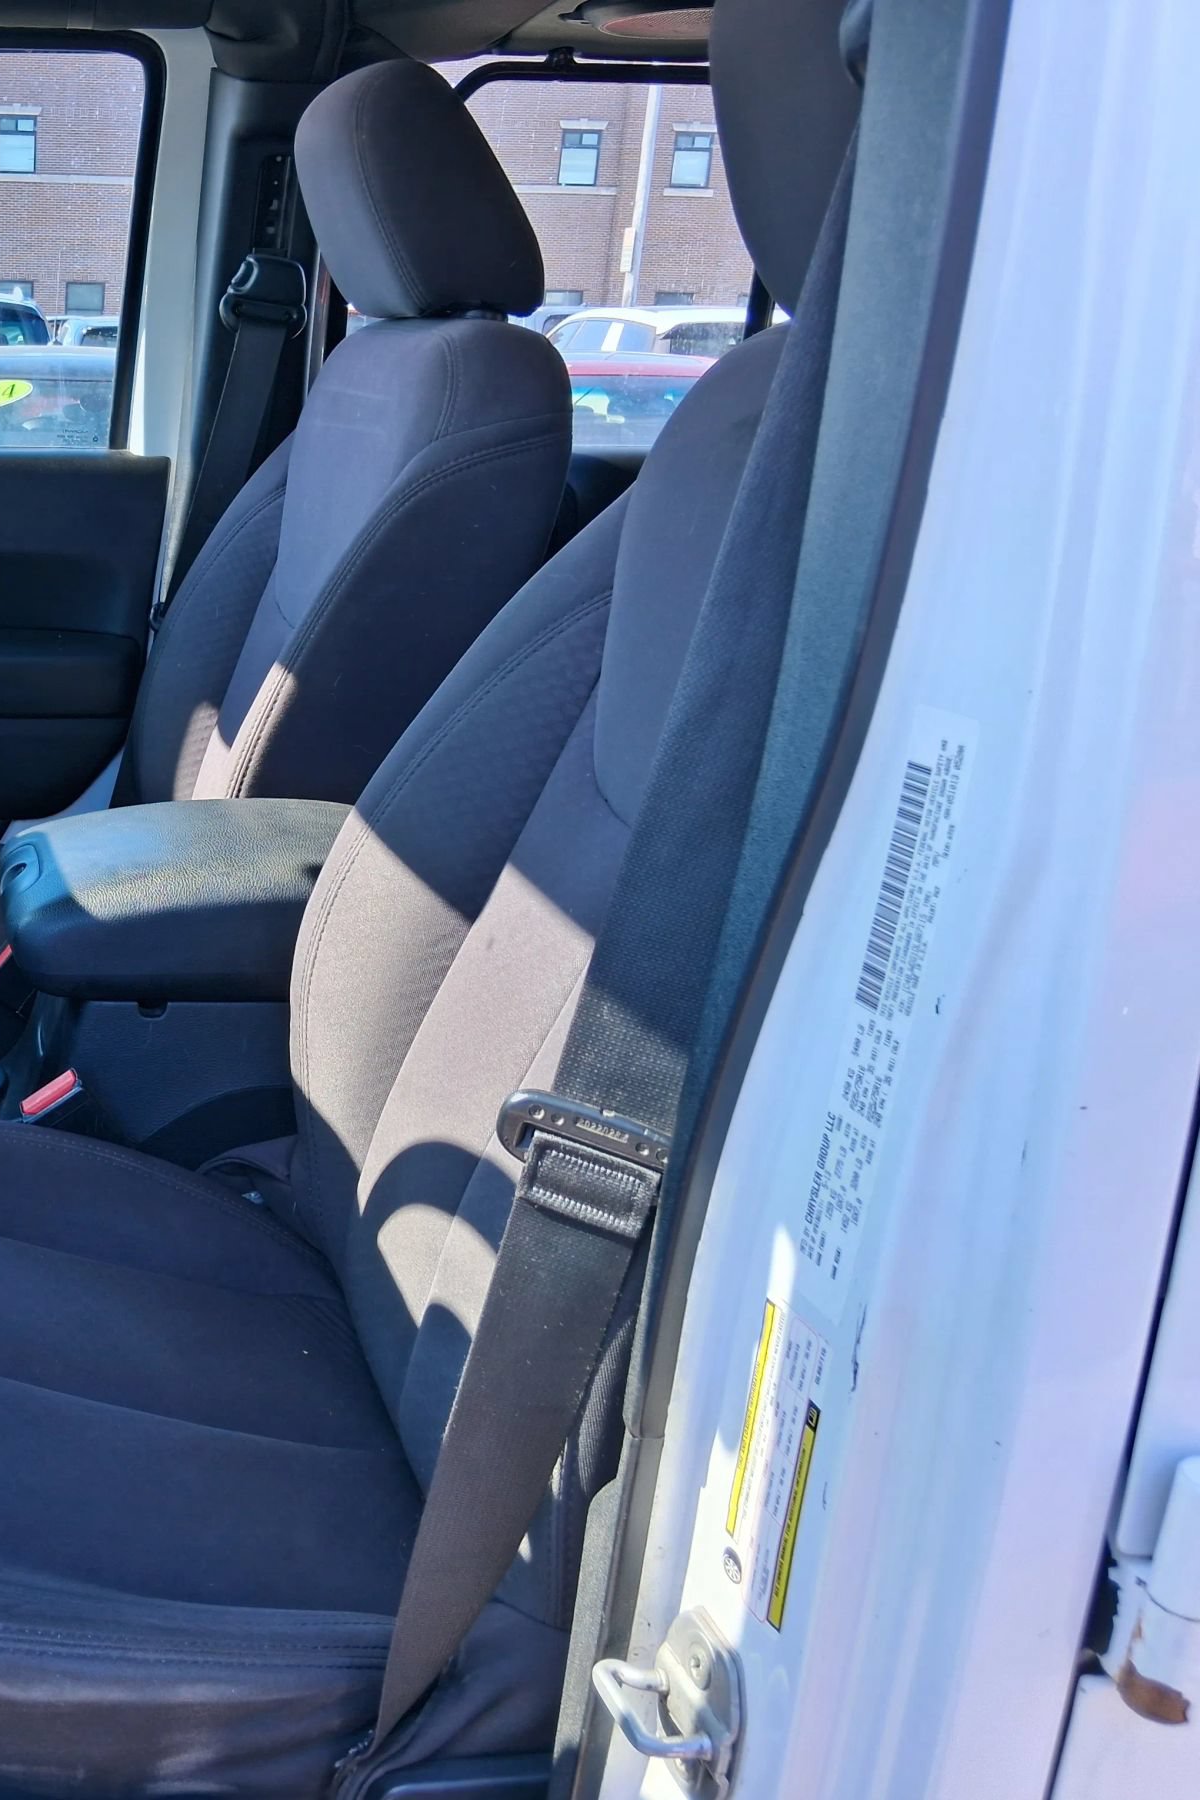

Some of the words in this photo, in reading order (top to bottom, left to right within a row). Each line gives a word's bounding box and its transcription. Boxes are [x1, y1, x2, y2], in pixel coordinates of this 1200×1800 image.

[804, 1170, 823, 1225] CHRYSLER
[816, 1132, 831, 1170] GROUP
[824, 1110, 836, 1132] LLC
